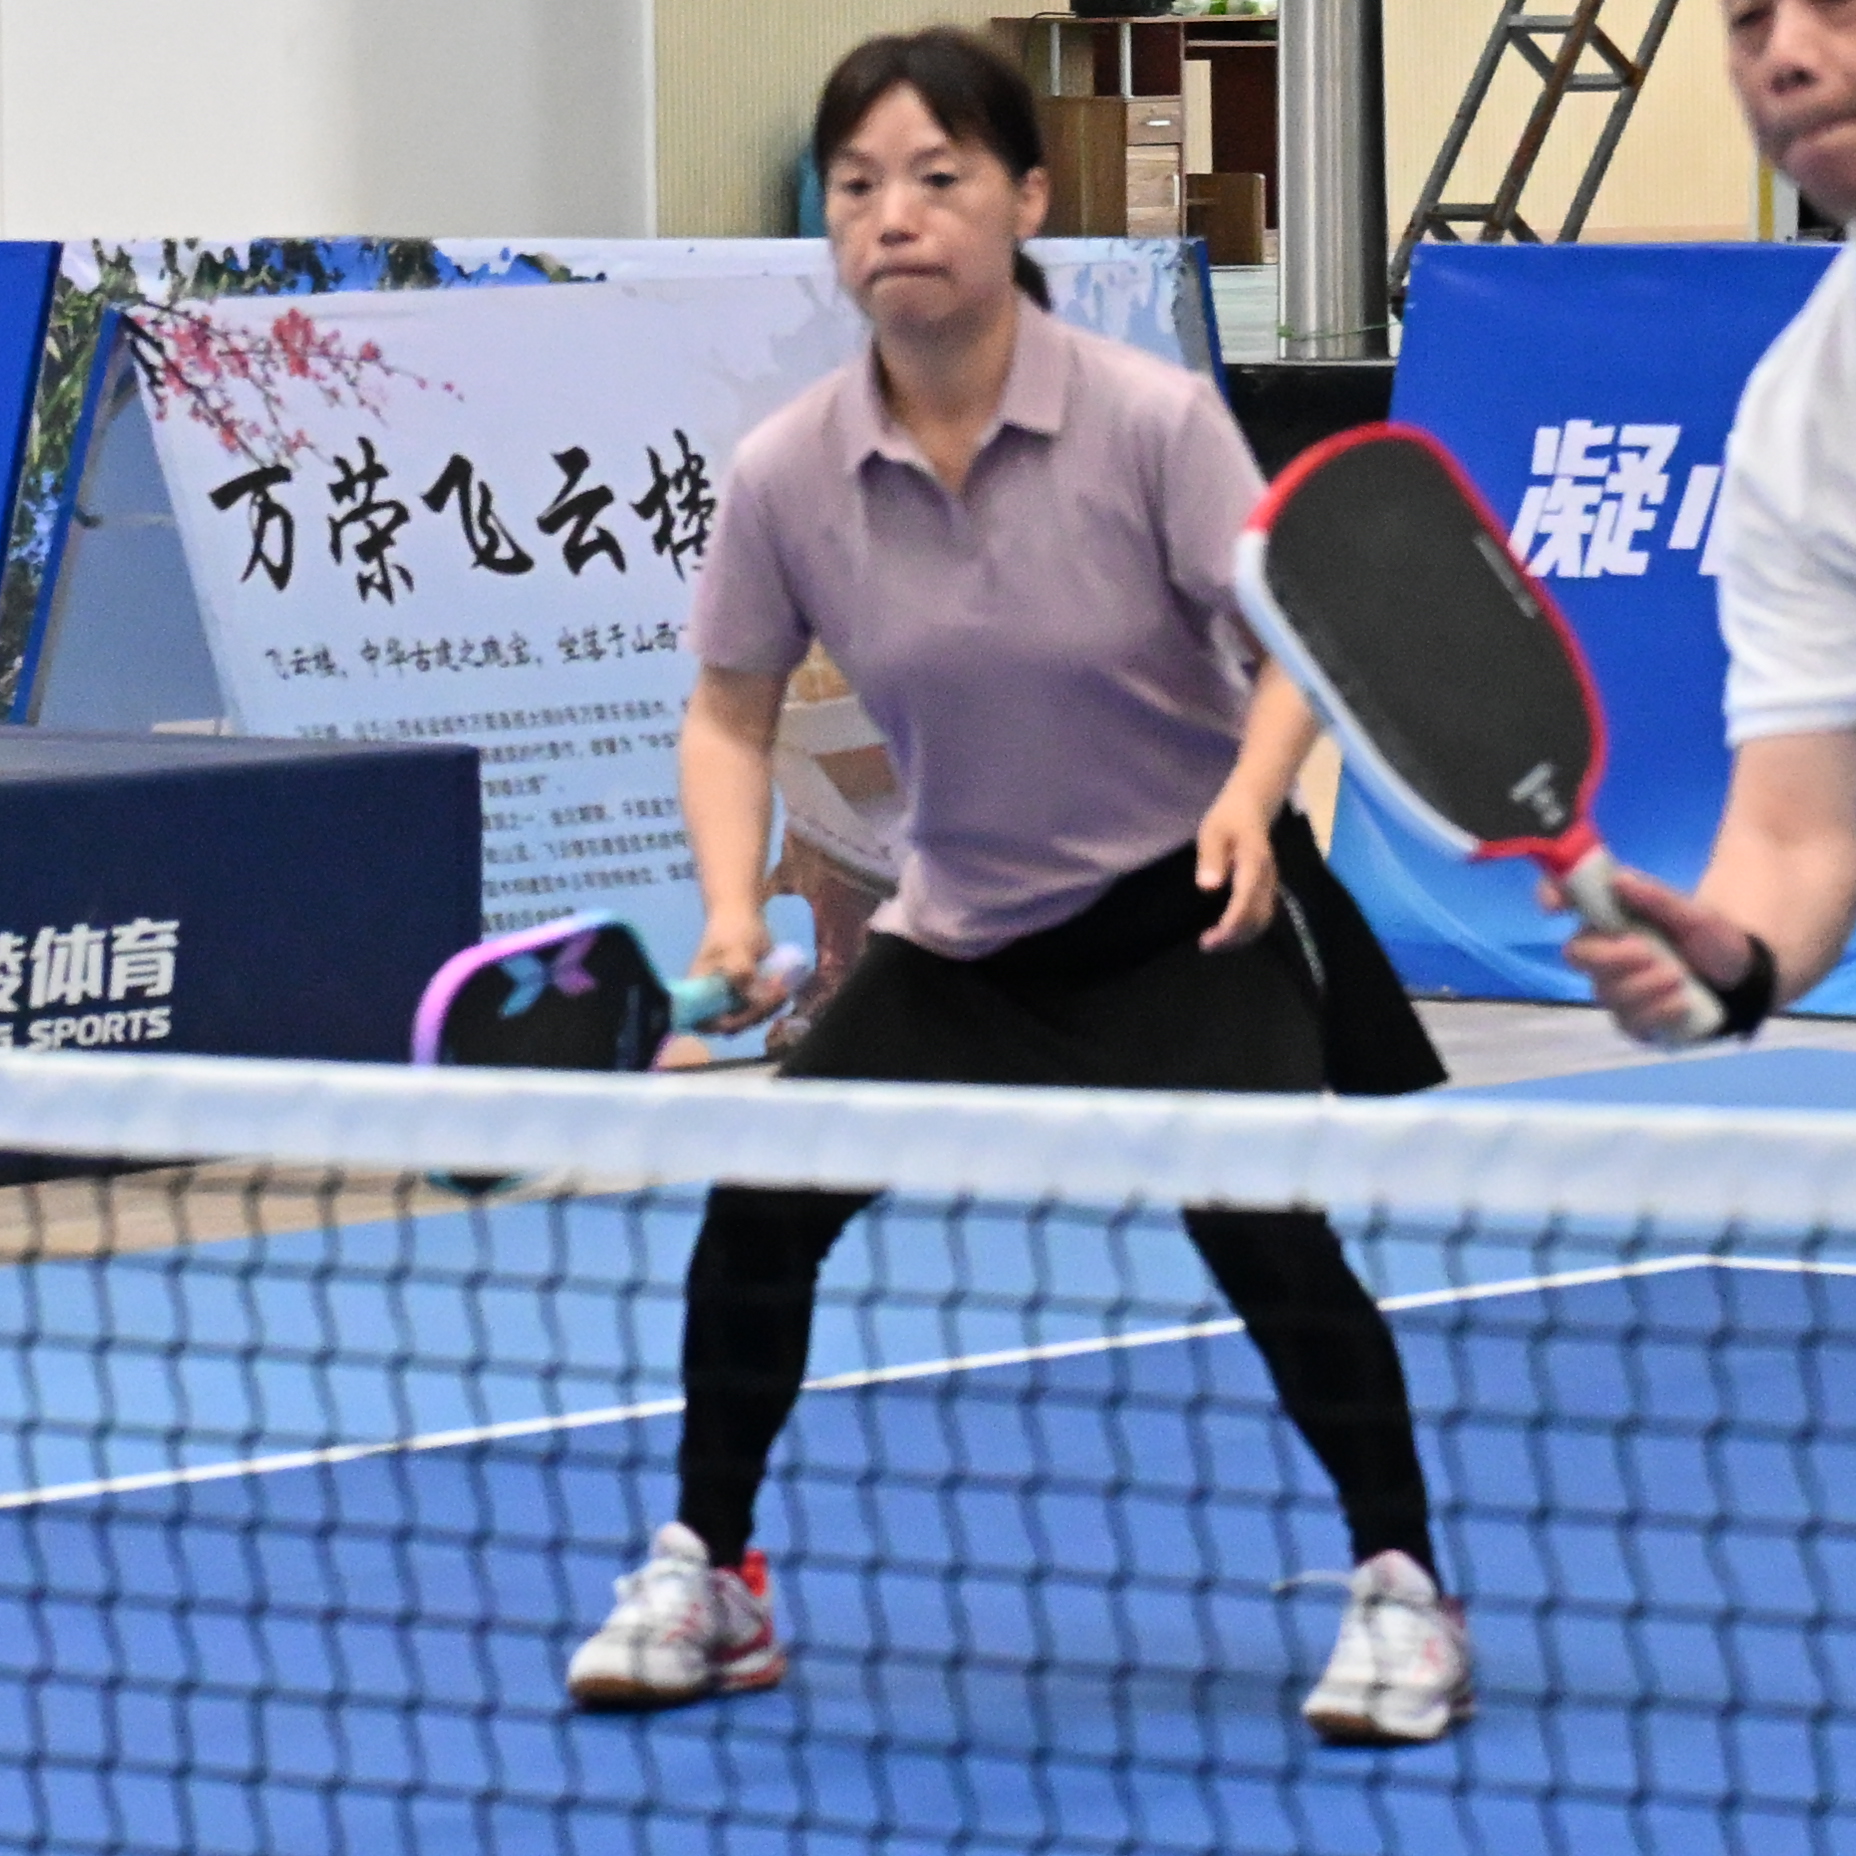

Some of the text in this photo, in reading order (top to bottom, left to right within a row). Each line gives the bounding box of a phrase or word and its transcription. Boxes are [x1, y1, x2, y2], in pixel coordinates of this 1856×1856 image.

[208, 428, 717, 605] 万荣飞云楼
[27, 1005, 173, 1051] SPORTS
